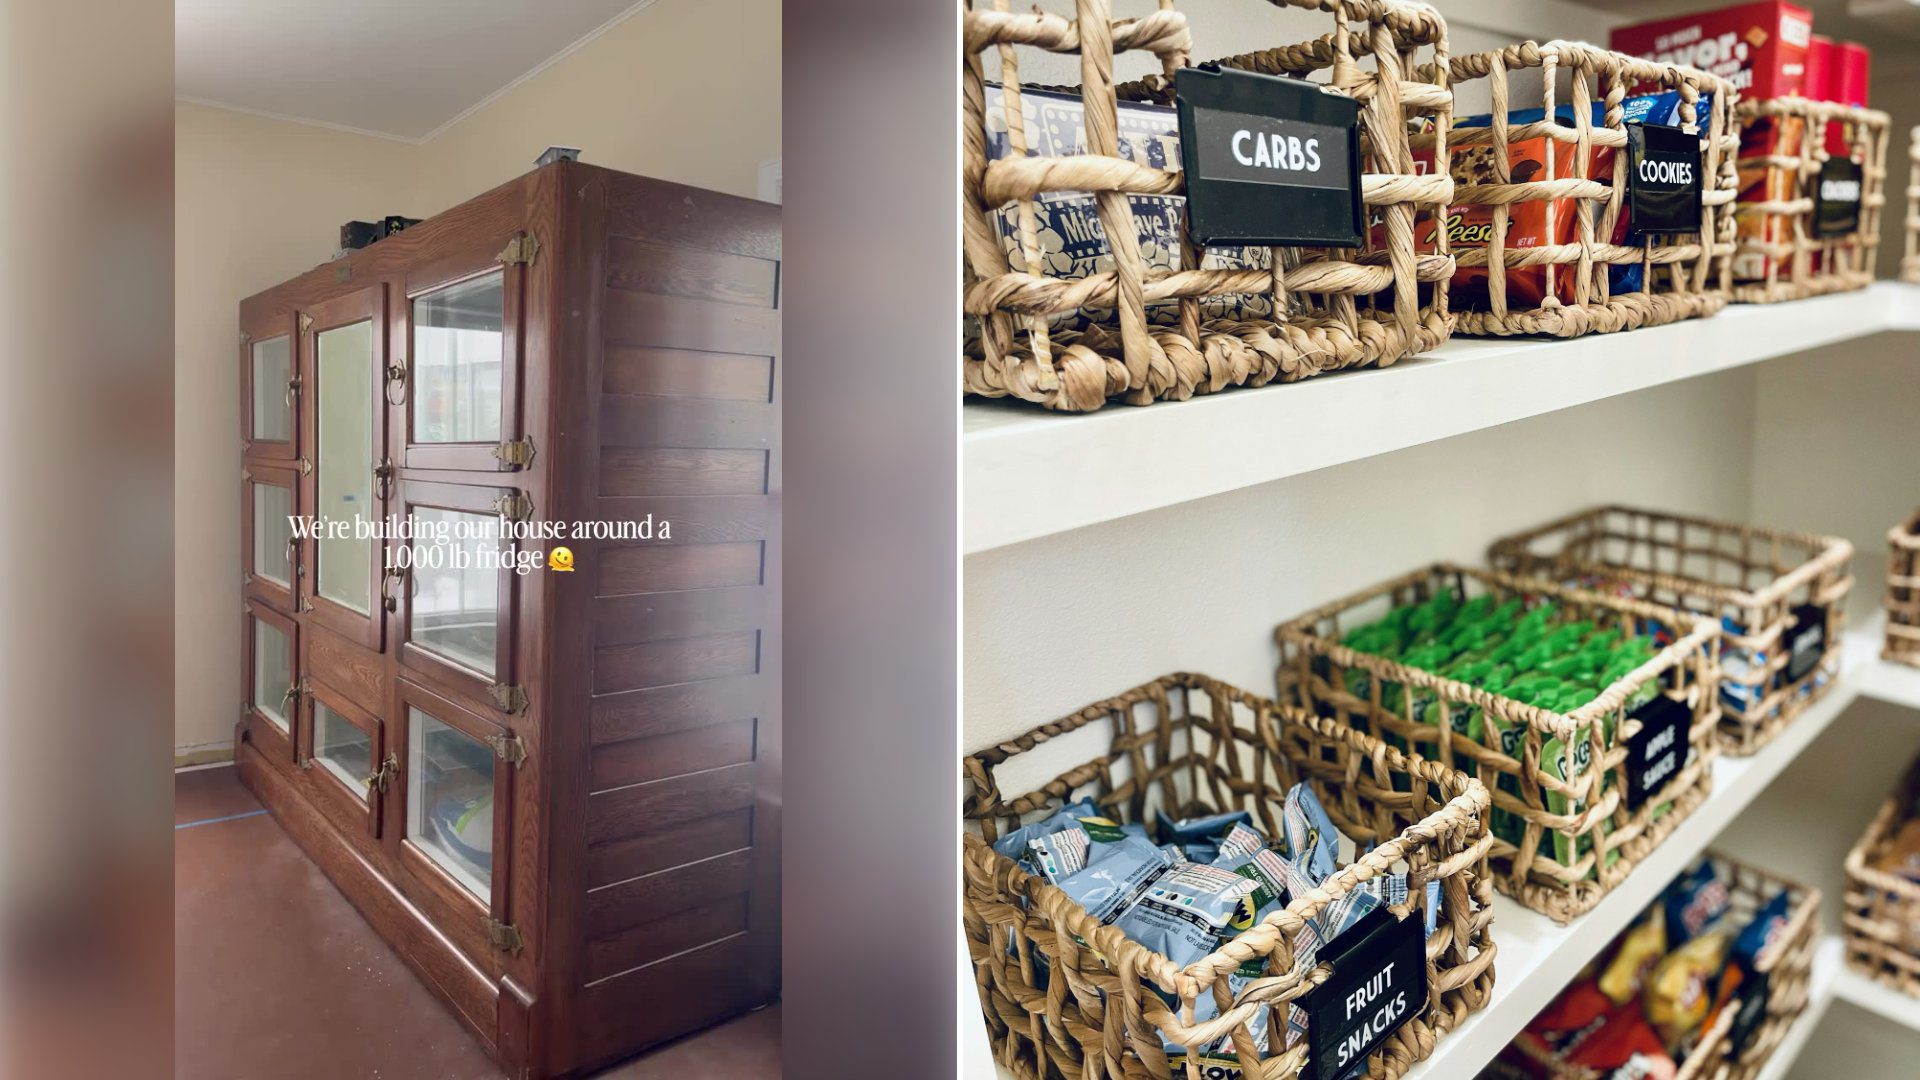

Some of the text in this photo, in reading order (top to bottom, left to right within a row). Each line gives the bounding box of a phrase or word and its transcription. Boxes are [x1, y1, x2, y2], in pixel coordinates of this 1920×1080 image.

[1231, 129, 1321, 173] CARBS
[1639, 159, 1693, 185] COOKIES
[1059, 208, 1165, 245] Micave
[1345, 961, 1395, 1021] FRUIT
[1337, 990, 1407, 1068] SNACKS
